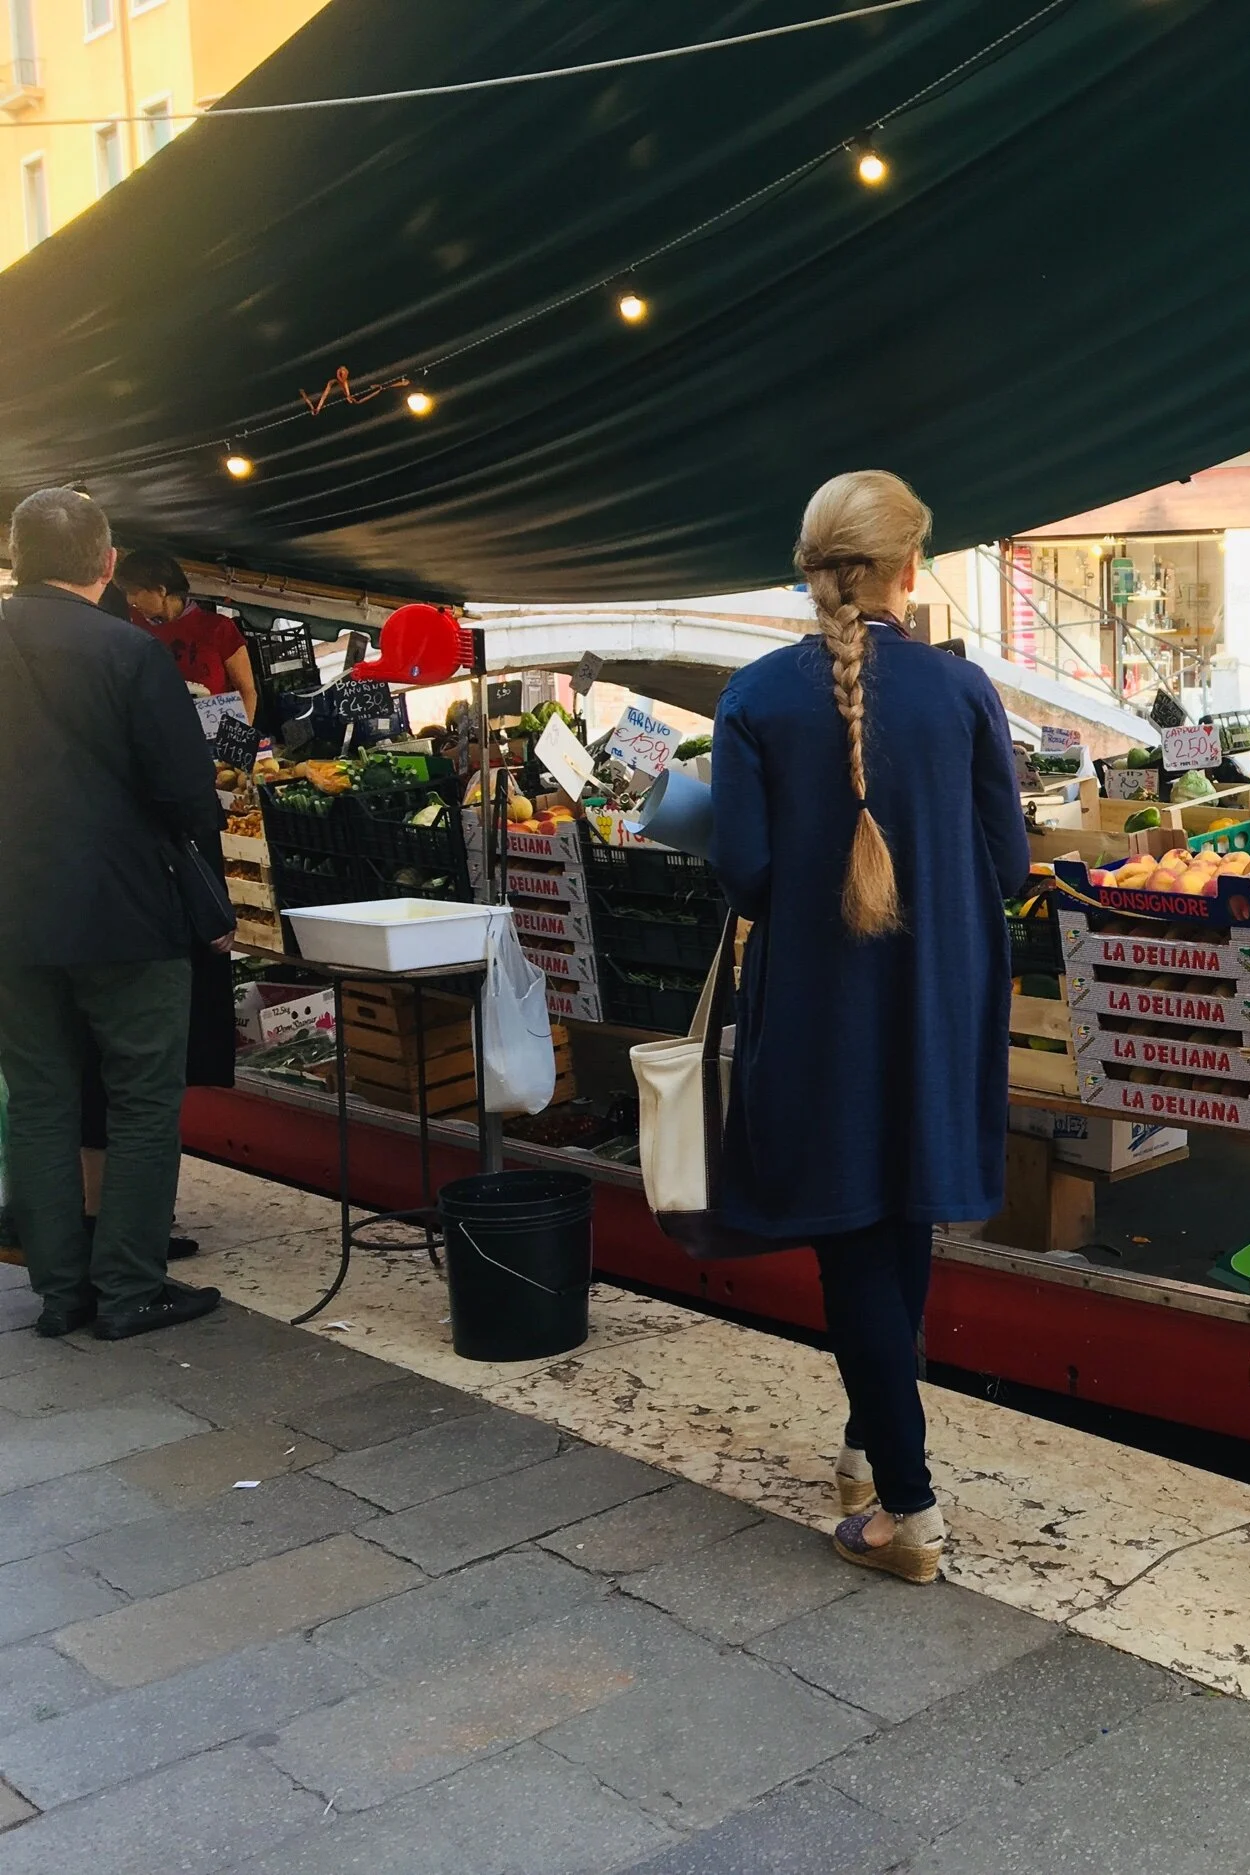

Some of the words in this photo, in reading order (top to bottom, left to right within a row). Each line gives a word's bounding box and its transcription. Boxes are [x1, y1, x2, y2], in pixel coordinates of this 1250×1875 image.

[627, 706, 671, 736] TARDIVO
[509, 875, 560, 897] DELIANA
[1100, 889, 1209, 918] BONSIGNORE
[515, 914, 565, 935] DELIANA
[1103, 941, 1126, 961] LA
[1133, 944, 1220, 971] DELIANA
[1108, 990, 1131, 1011] LA
[1137, 993, 1225, 1023] DELIANA
[1113, 1038, 1137, 1058] LA
[1143, 1042, 1231, 1072] DELIANA
[1121, 1088, 1145, 1109] LA
[1151, 1093, 1240, 1124] DELIANA
